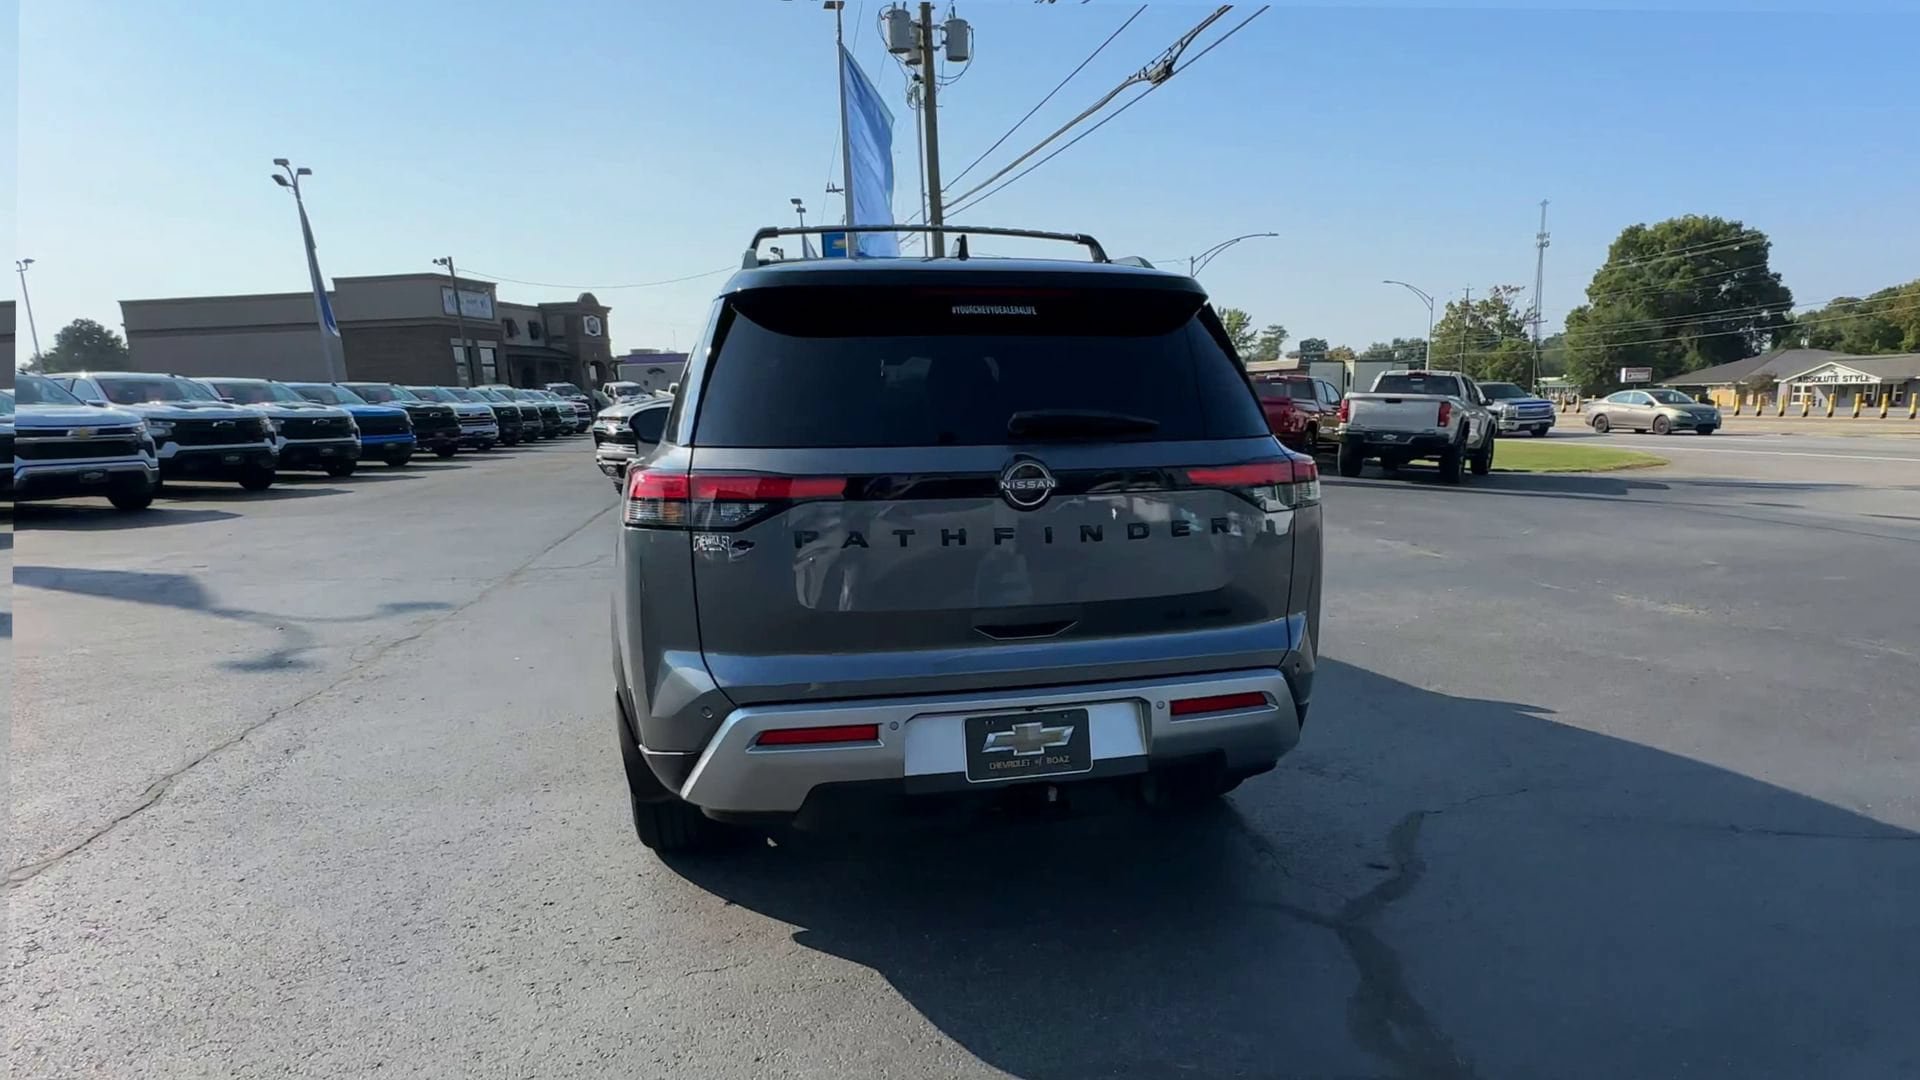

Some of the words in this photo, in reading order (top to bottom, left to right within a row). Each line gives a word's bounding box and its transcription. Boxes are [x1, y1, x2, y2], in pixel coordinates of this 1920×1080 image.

[1797, 374, 1839, 383] ABSOLUTE
[1842, 374, 1871, 383] STYLE
[1000, 479, 1056, 490] NISSAN
[793, 516, 1232, 549] PATHFINDER
[989, 759, 1031, 769] CHEVROLET
[1046, 755, 1070, 764] BOAZ
